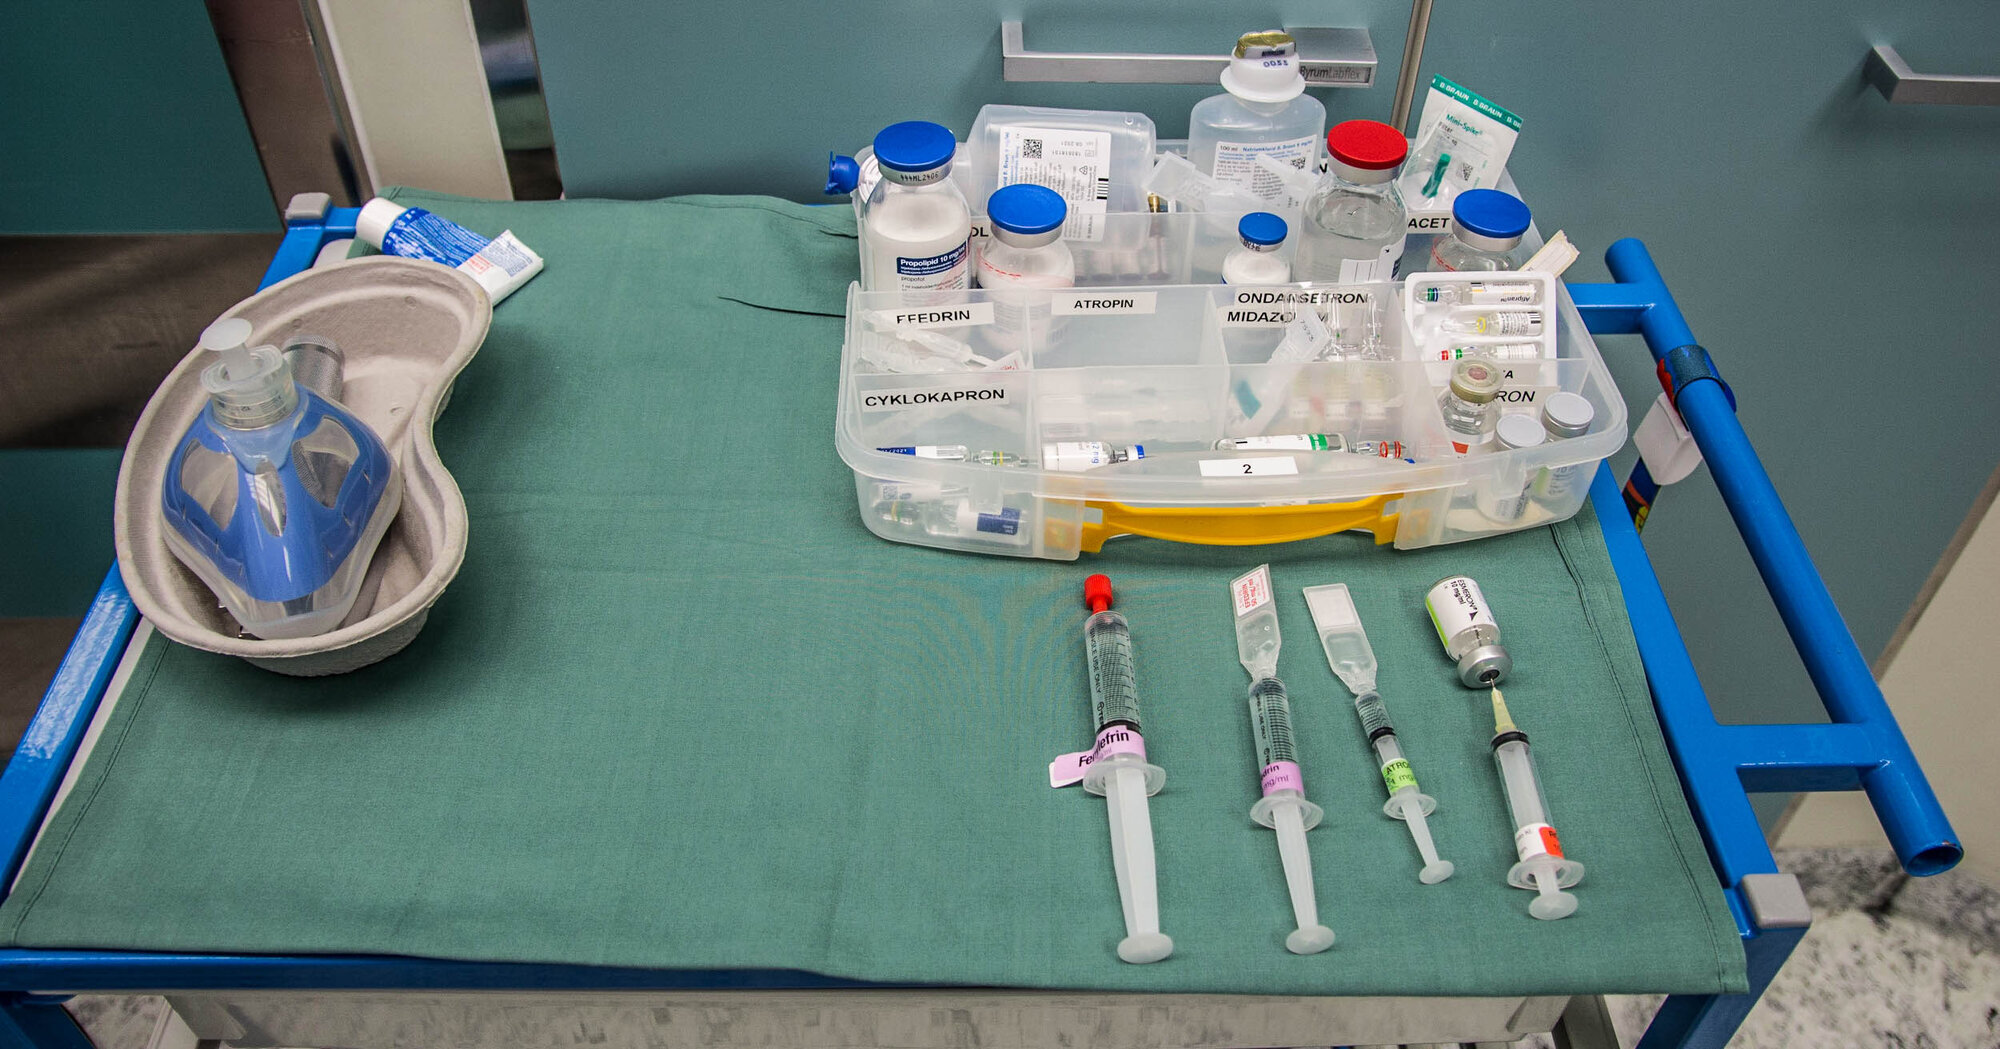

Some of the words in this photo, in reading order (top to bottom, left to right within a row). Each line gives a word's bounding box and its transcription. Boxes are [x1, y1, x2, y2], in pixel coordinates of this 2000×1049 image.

[900, 258, 939, 268] Propolipid
[940, 254, 949, 263] 10
[1074, 299, 1134, 309] ATROPIN
[865, 388, 1005, 407] CYKLOKAPRON
[1496, 391, 1535, 403] RON
[1242, 463, 1253, 474] 2
[1092, 653, 1100, 670] USE
[1386, 761, 1411, 775] ATRO
